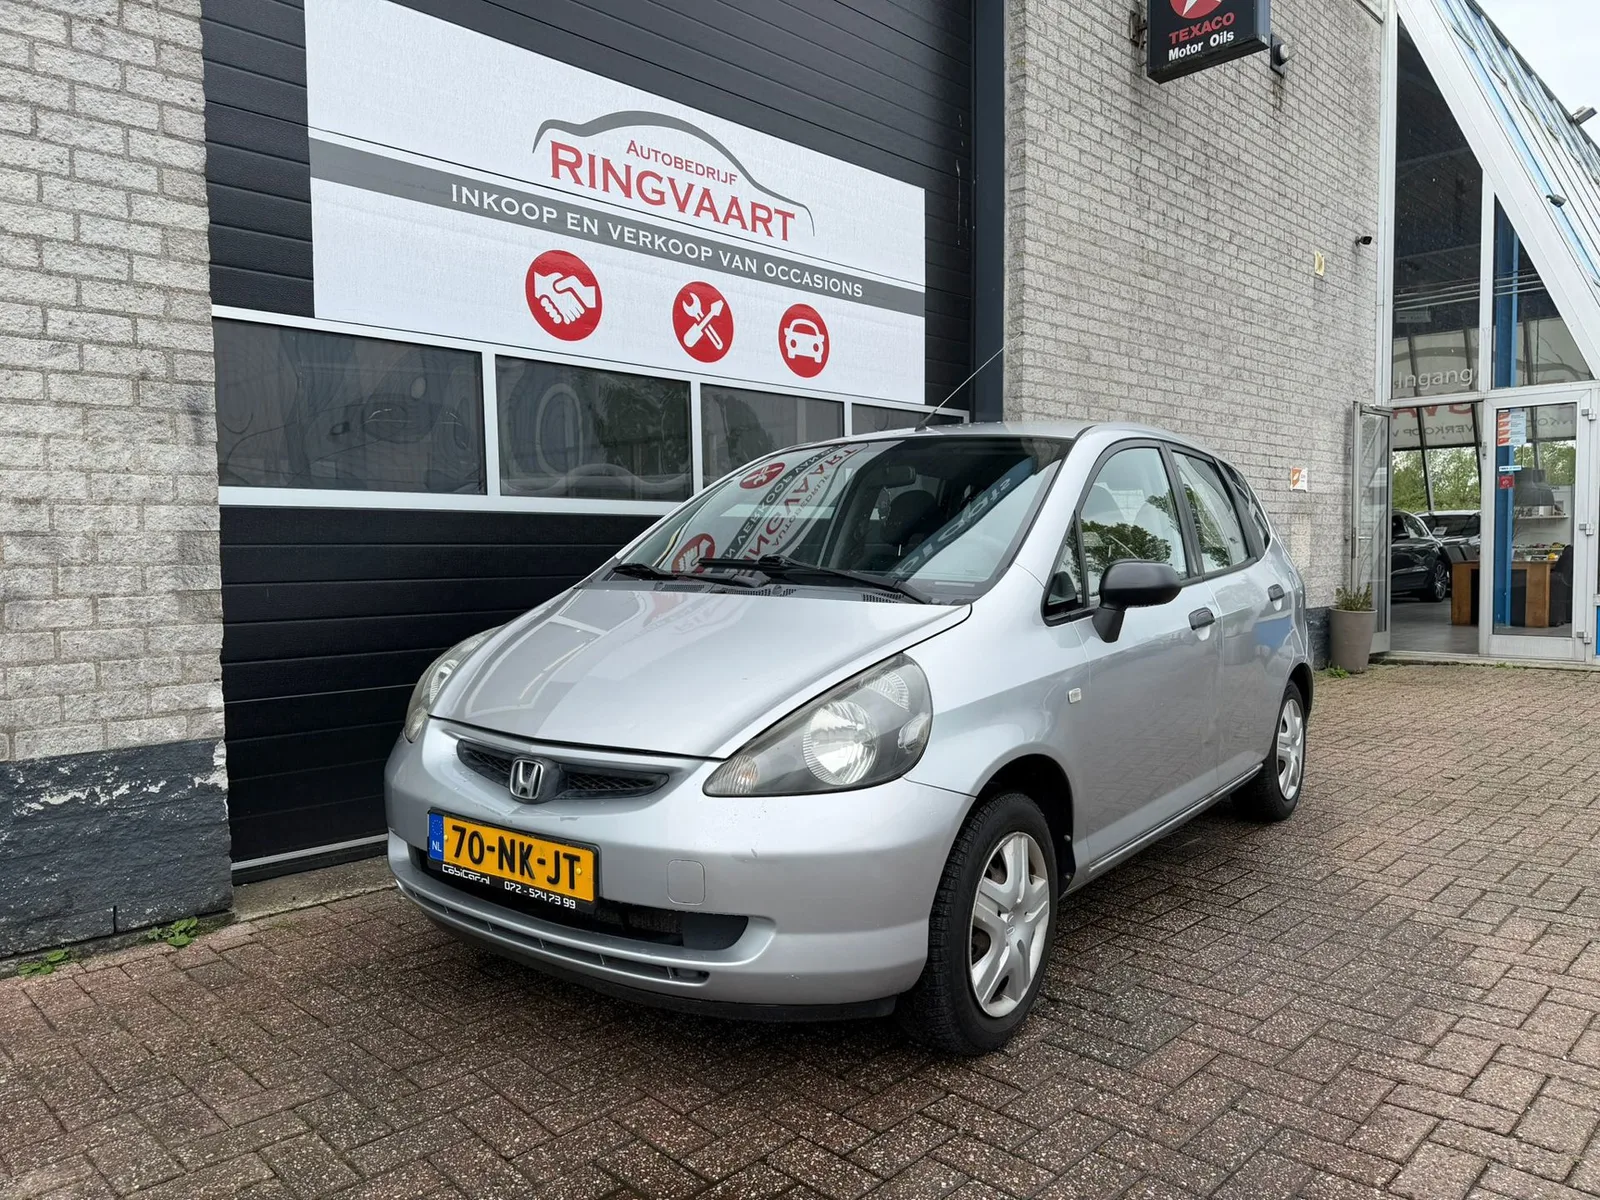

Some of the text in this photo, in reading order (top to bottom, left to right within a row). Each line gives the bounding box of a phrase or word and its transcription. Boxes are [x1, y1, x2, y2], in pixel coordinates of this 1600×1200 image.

[1168, 30, 1235, 61] Motor Oils
[1169, 12, 1235, 45] TEXACO
[626, 139, 738, 185] AUTOBEDRIJF
[550, 141, 795, 241] RINGVAART
[452, 184, 863, 297] INKOOP EN VERKOOP VAN OCCASIONS
[431, 840, 442, 852] NL
[452, 824, 581, 890] 70-NK-JT
[504, 880, 522, 894] 072
[529, 888, 547, 902] 574
[548, 893, 561, 906] 73
[563, 897, 576, 910] 99
